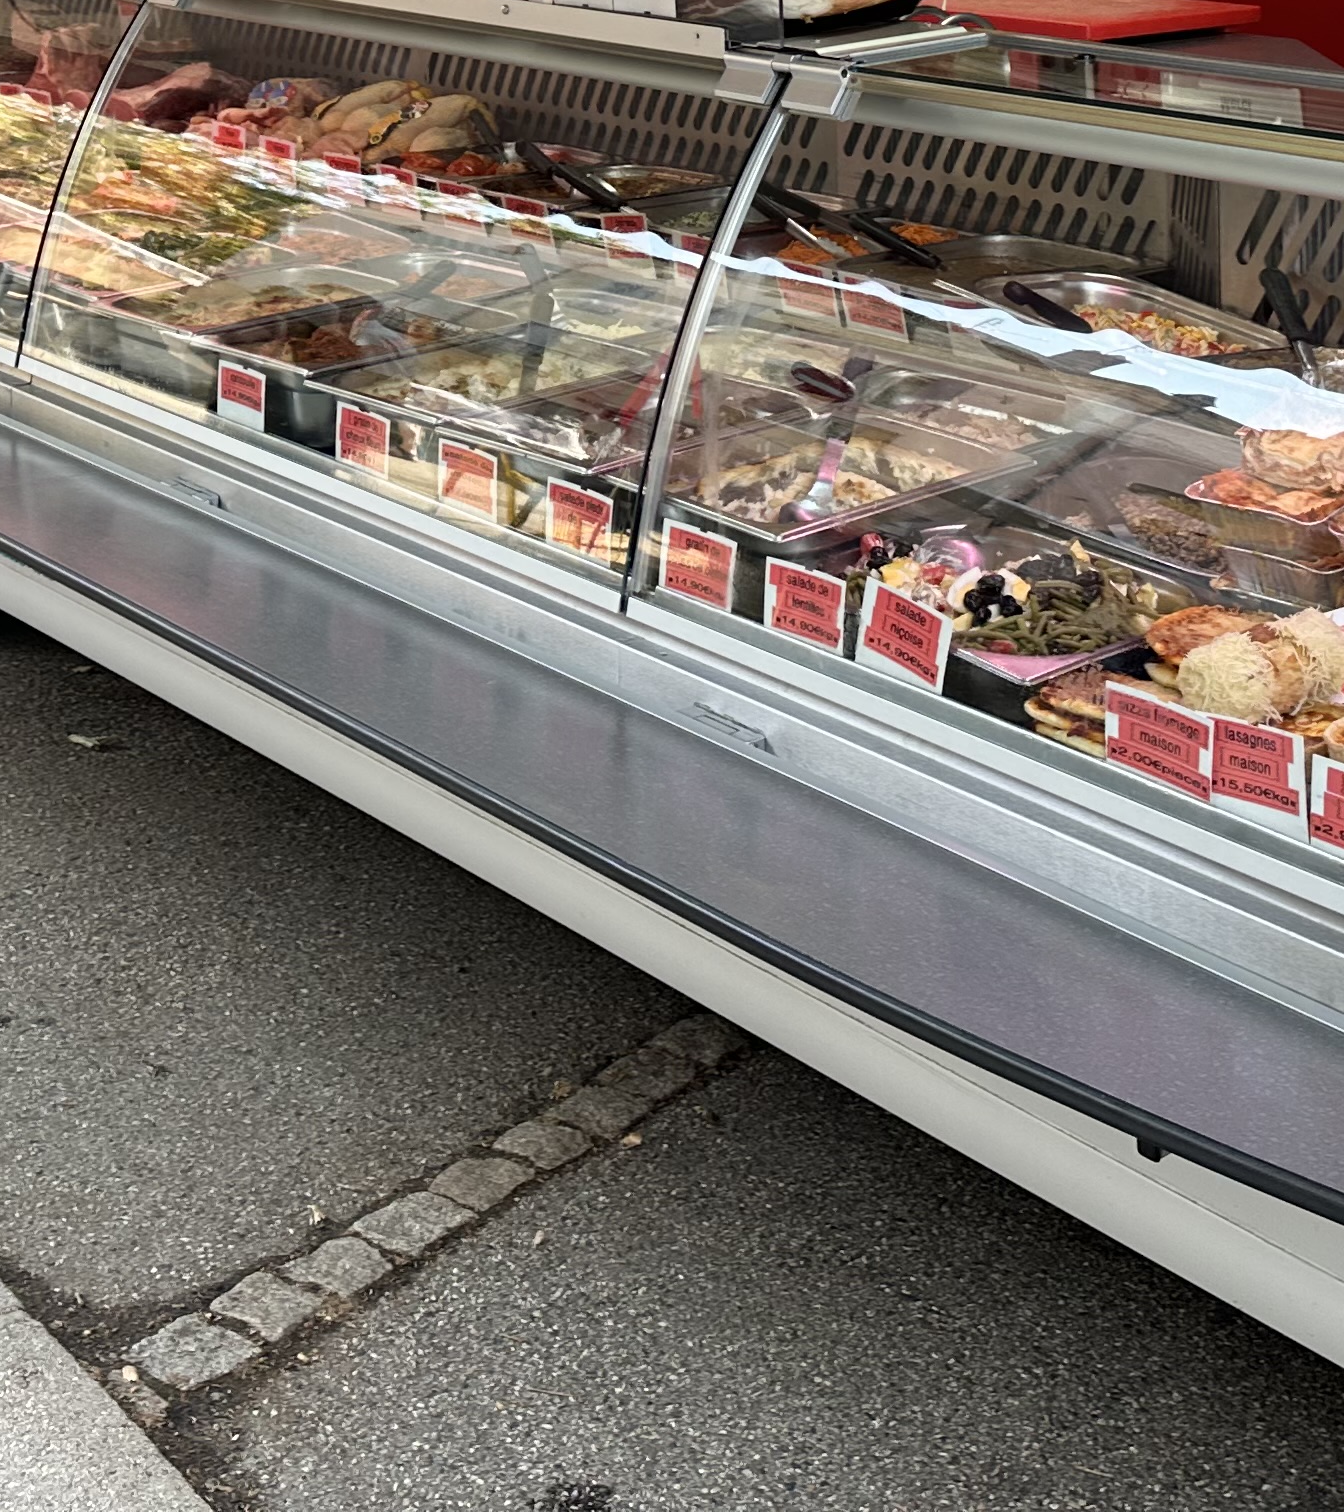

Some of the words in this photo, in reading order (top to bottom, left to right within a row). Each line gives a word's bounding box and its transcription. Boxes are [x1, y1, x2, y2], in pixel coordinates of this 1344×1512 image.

[786, 574, 816, 593] salade
[895, 601, 927, 627] salade
[890, 623, 924, 648] niçoise
[1140, 730, 1182, 756] maison
[1224, 726, 1277, 752] lasagnes
[1229, 753, 1271, 776] maison
